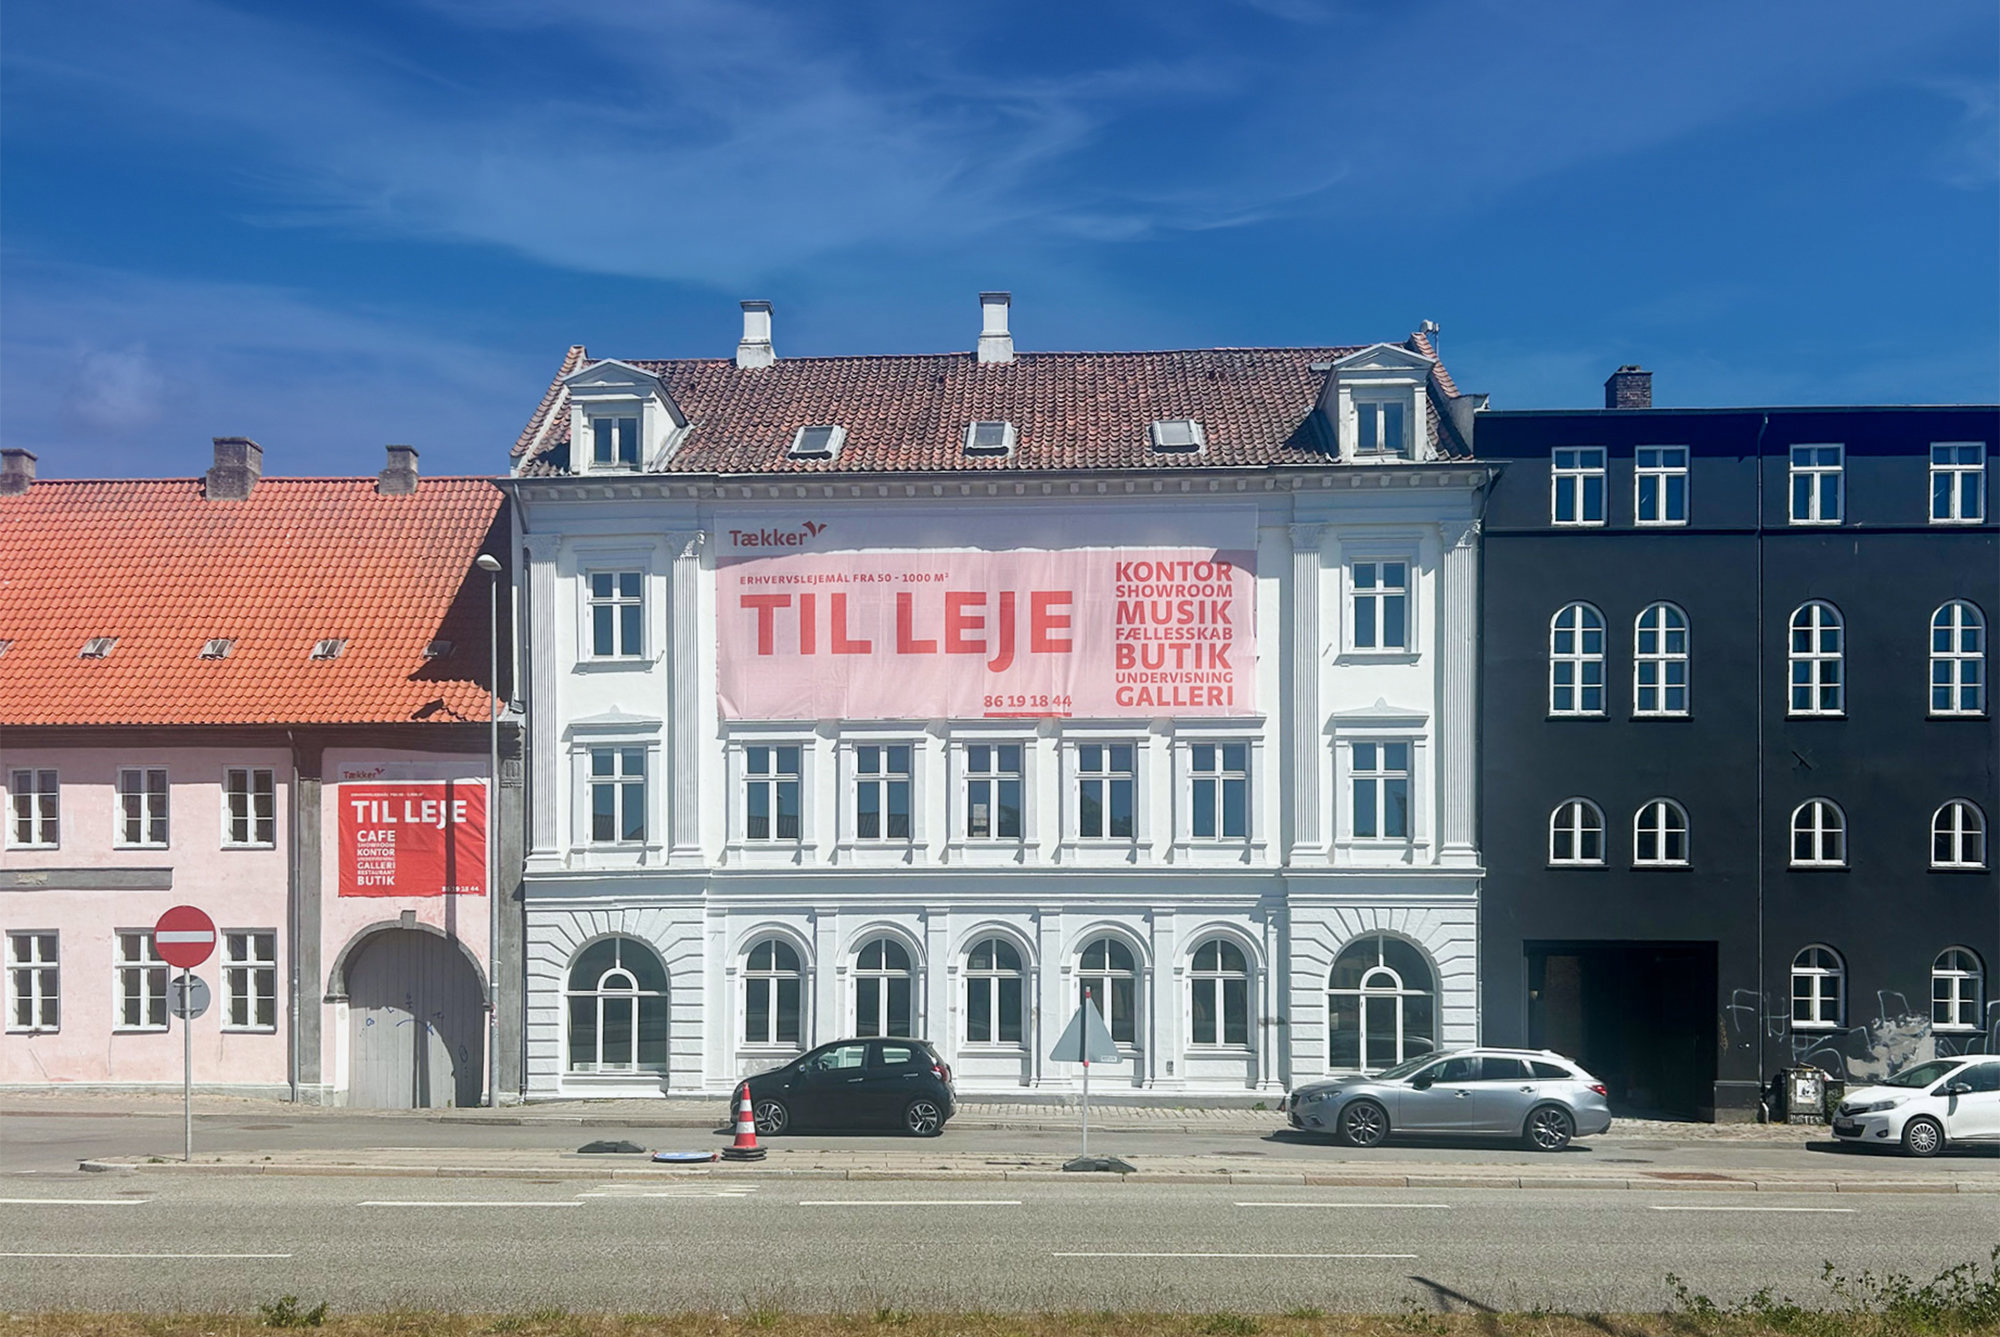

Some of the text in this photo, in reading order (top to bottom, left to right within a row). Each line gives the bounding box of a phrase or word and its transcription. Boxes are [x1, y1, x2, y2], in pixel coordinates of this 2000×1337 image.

[728, 528, 808, 547] Tækker
[1115, 561, 1233, 582] KONTOR
[740, 572, 850, 585] ERHVERVSLEJEMÅL
[853, 573, 875, 583] FRA
[878, 573, 892, 583] 50
[902, 573, 931, 583] 1000
[1115, 584, 1233, 598] SHOWROOM
[1115, 600, 1233, 625] MUSIK
[740, 591, 1073, 673] TIL LEJE
[1115, 627, 1233, 640] FÆLLESSKAB
[1115, 643, 1233, 670] BUTIK
[1115, 672, 1233, 684] UNDERVISNING
[983, 695, 1072, 708] 86 19 18 44
[1115, 686, 1233, 707] GALLERI
[351, 800, 467, 830] TIL LEJE
[357, 830, 396, 842] CAFE
[357, 848, 396, 856] KONTOR
[357, 861, 396, 869] GALLERI
[357, 875, 396, 886] BUTIK
